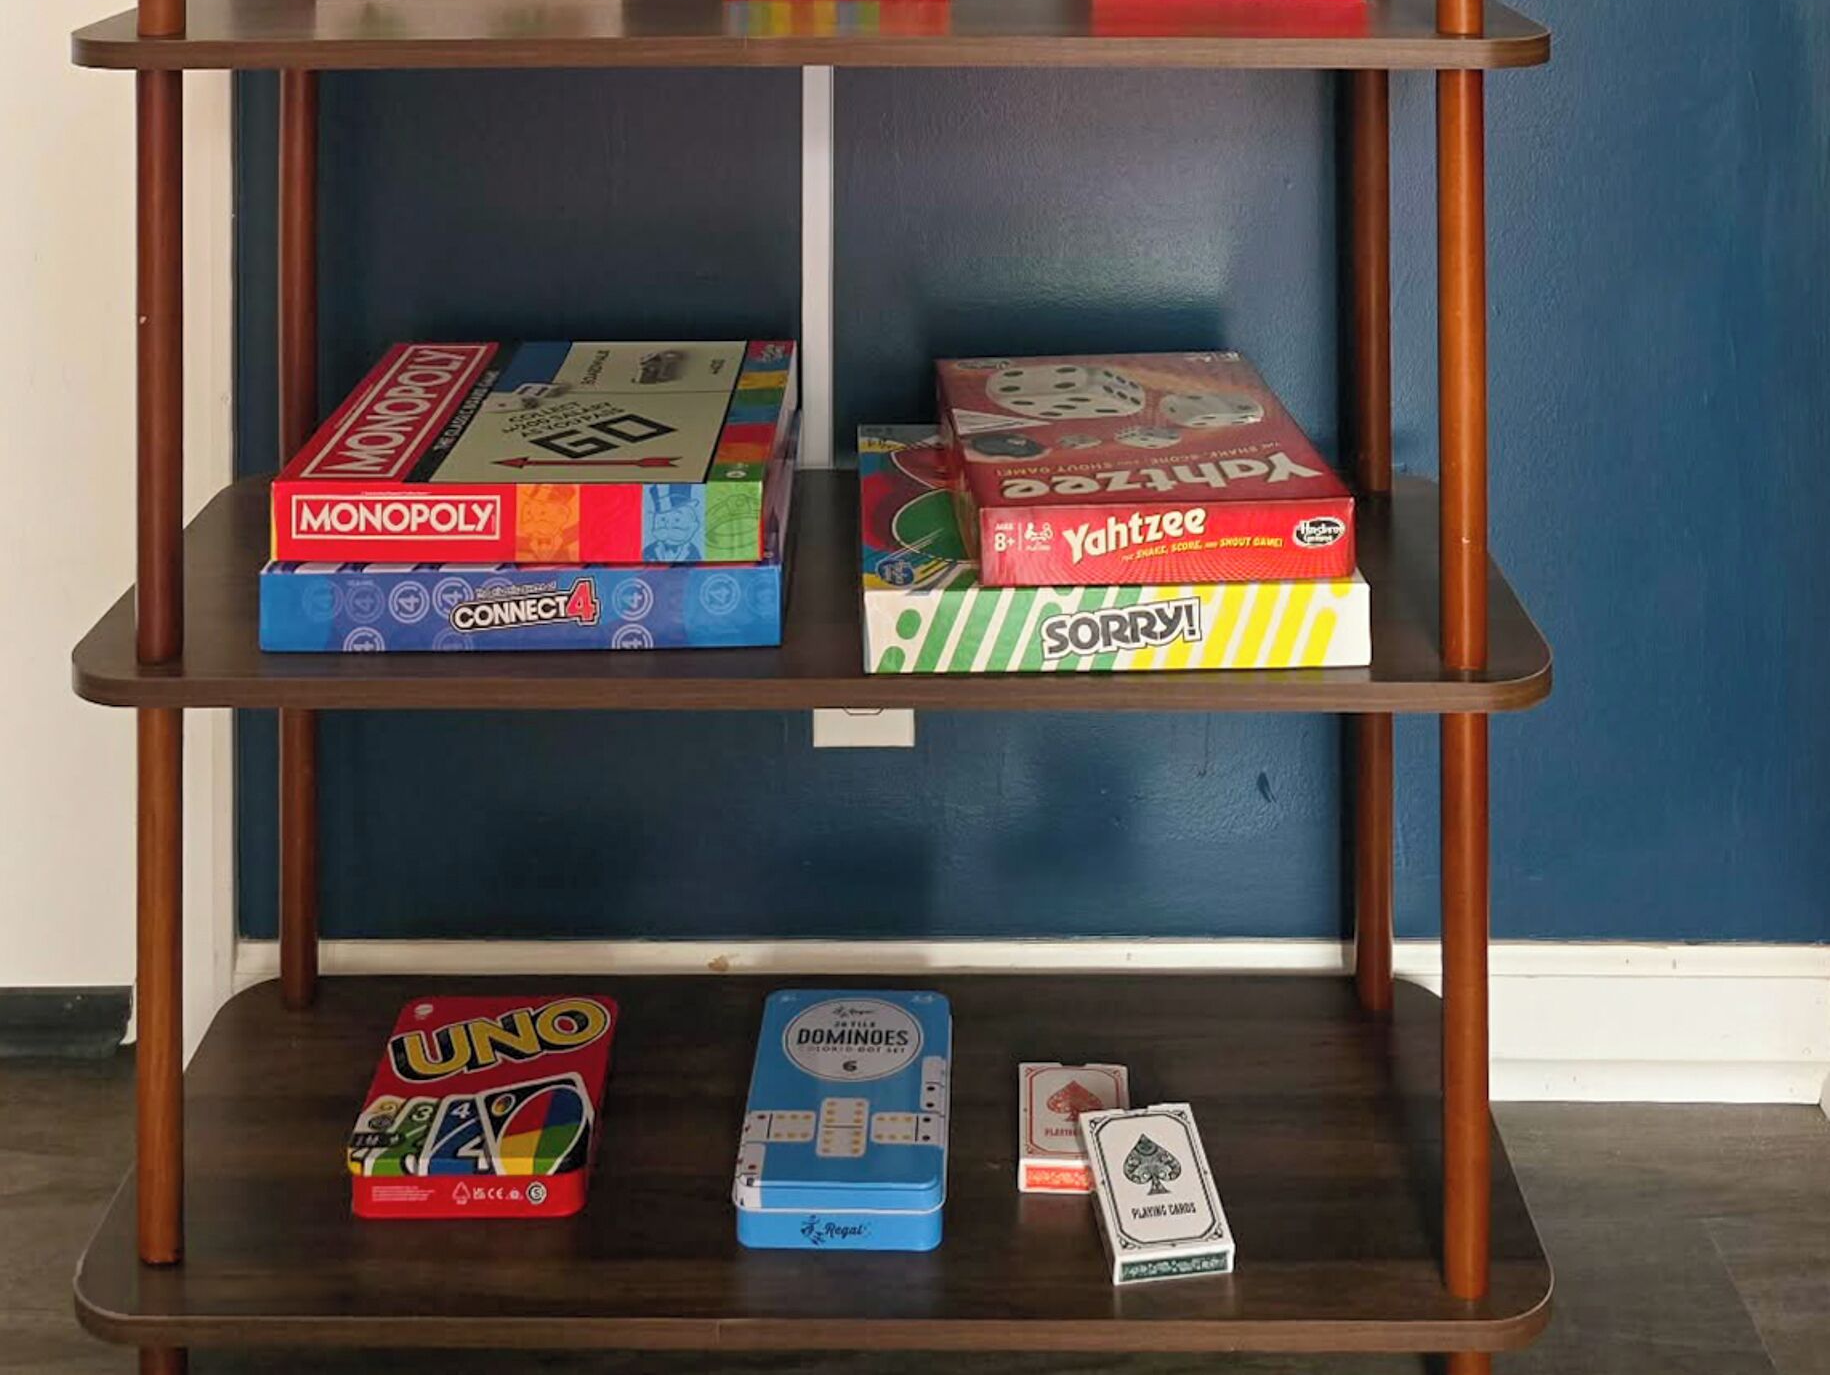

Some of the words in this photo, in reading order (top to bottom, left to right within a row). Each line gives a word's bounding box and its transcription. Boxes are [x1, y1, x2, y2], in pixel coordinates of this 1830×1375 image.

[322, 348, 467, 472] MONOPOLY
[528, 413, 680, 459] GO
[1002, 451, 1323, 499] Yahtzee
[300, 502, 494, 533] MONOPOLY
[994, 532, 1016, 553] 8+
[1061, 508, 1207, 566] Yahtzee
[453, 595, 567, 630] CONNECT
[565, 579, 598, 622] 4
[1044, 602, 1198, 656] SORRY!
[388, 998, 610, 1083] UNO
[796, 1028, 909, 1046] DOMINOES
[842, 1060, 858, 1073] 6
[412, 1105, 434, 1122] 3
[450, 1101, 471, 1119] 4
[1131, 1204, 1167, 1220] PLAYING
[1168, 1201, 1197, 1216] CARDS
[824, 1221, 864, 1240] Regal
